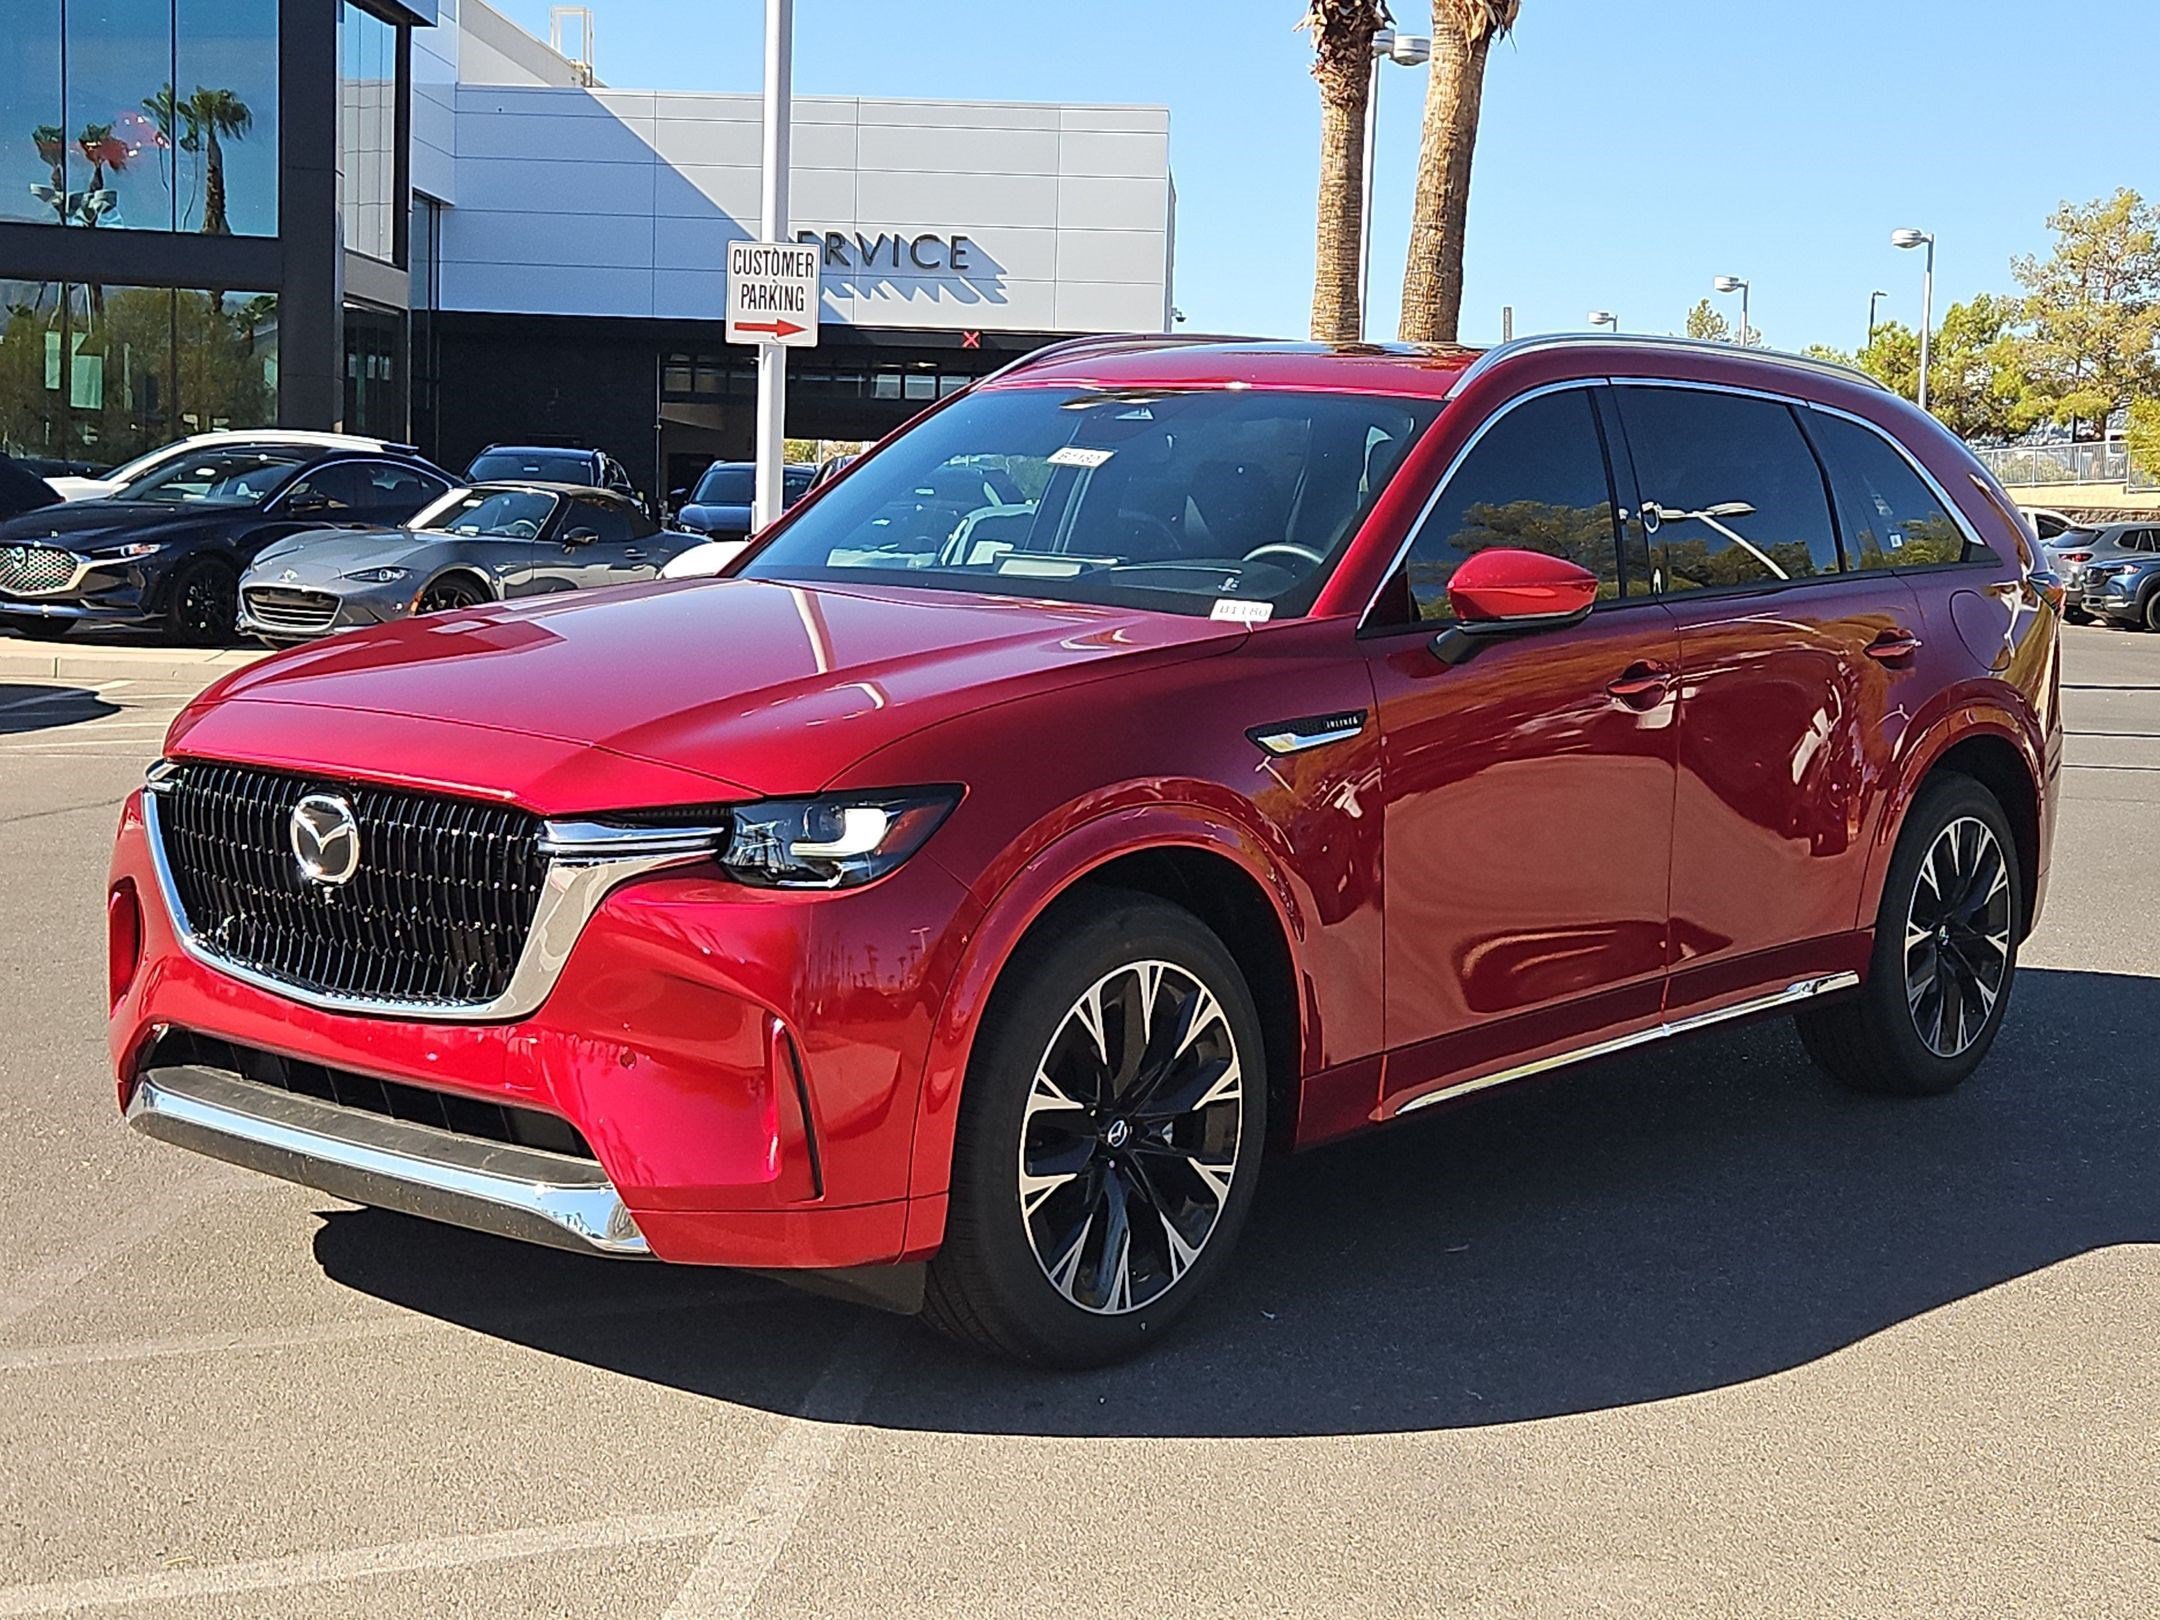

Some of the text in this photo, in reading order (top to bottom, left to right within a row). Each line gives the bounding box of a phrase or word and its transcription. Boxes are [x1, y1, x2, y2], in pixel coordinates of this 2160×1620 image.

[733, 248, 815, 278] CUSTOMER
[797, 230, 970, 270] RVICE
[740, 283, 805, 312] PARKING
